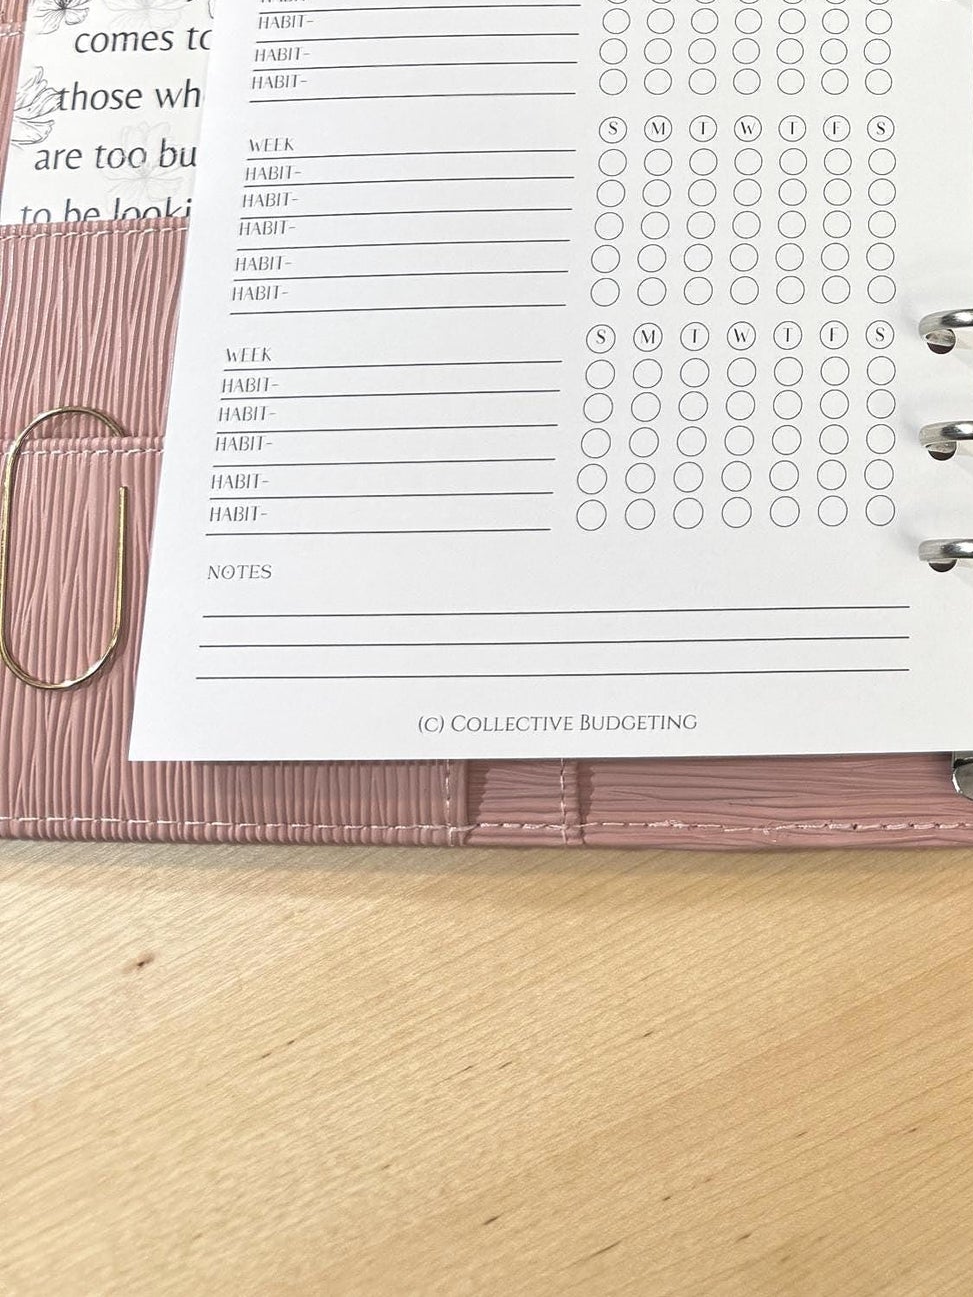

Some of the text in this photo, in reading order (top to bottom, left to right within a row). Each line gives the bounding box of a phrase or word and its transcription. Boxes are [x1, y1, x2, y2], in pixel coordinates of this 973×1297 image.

[75, 28, 173, 52] comes
[59, 81, 142, 110] those
[249, 137, 295, 153] WEEK
[34, 147, 83, 170] are
[95, 145, 147, 169] too
[20, 206, 52, 224] to
[226, 346, 272, 363] WEEK
[207, 564, 272, 580] NOTES
[450, 714, 574, 733] COLLECTIVE
[579, 713, 698, 731] BUDGETING
